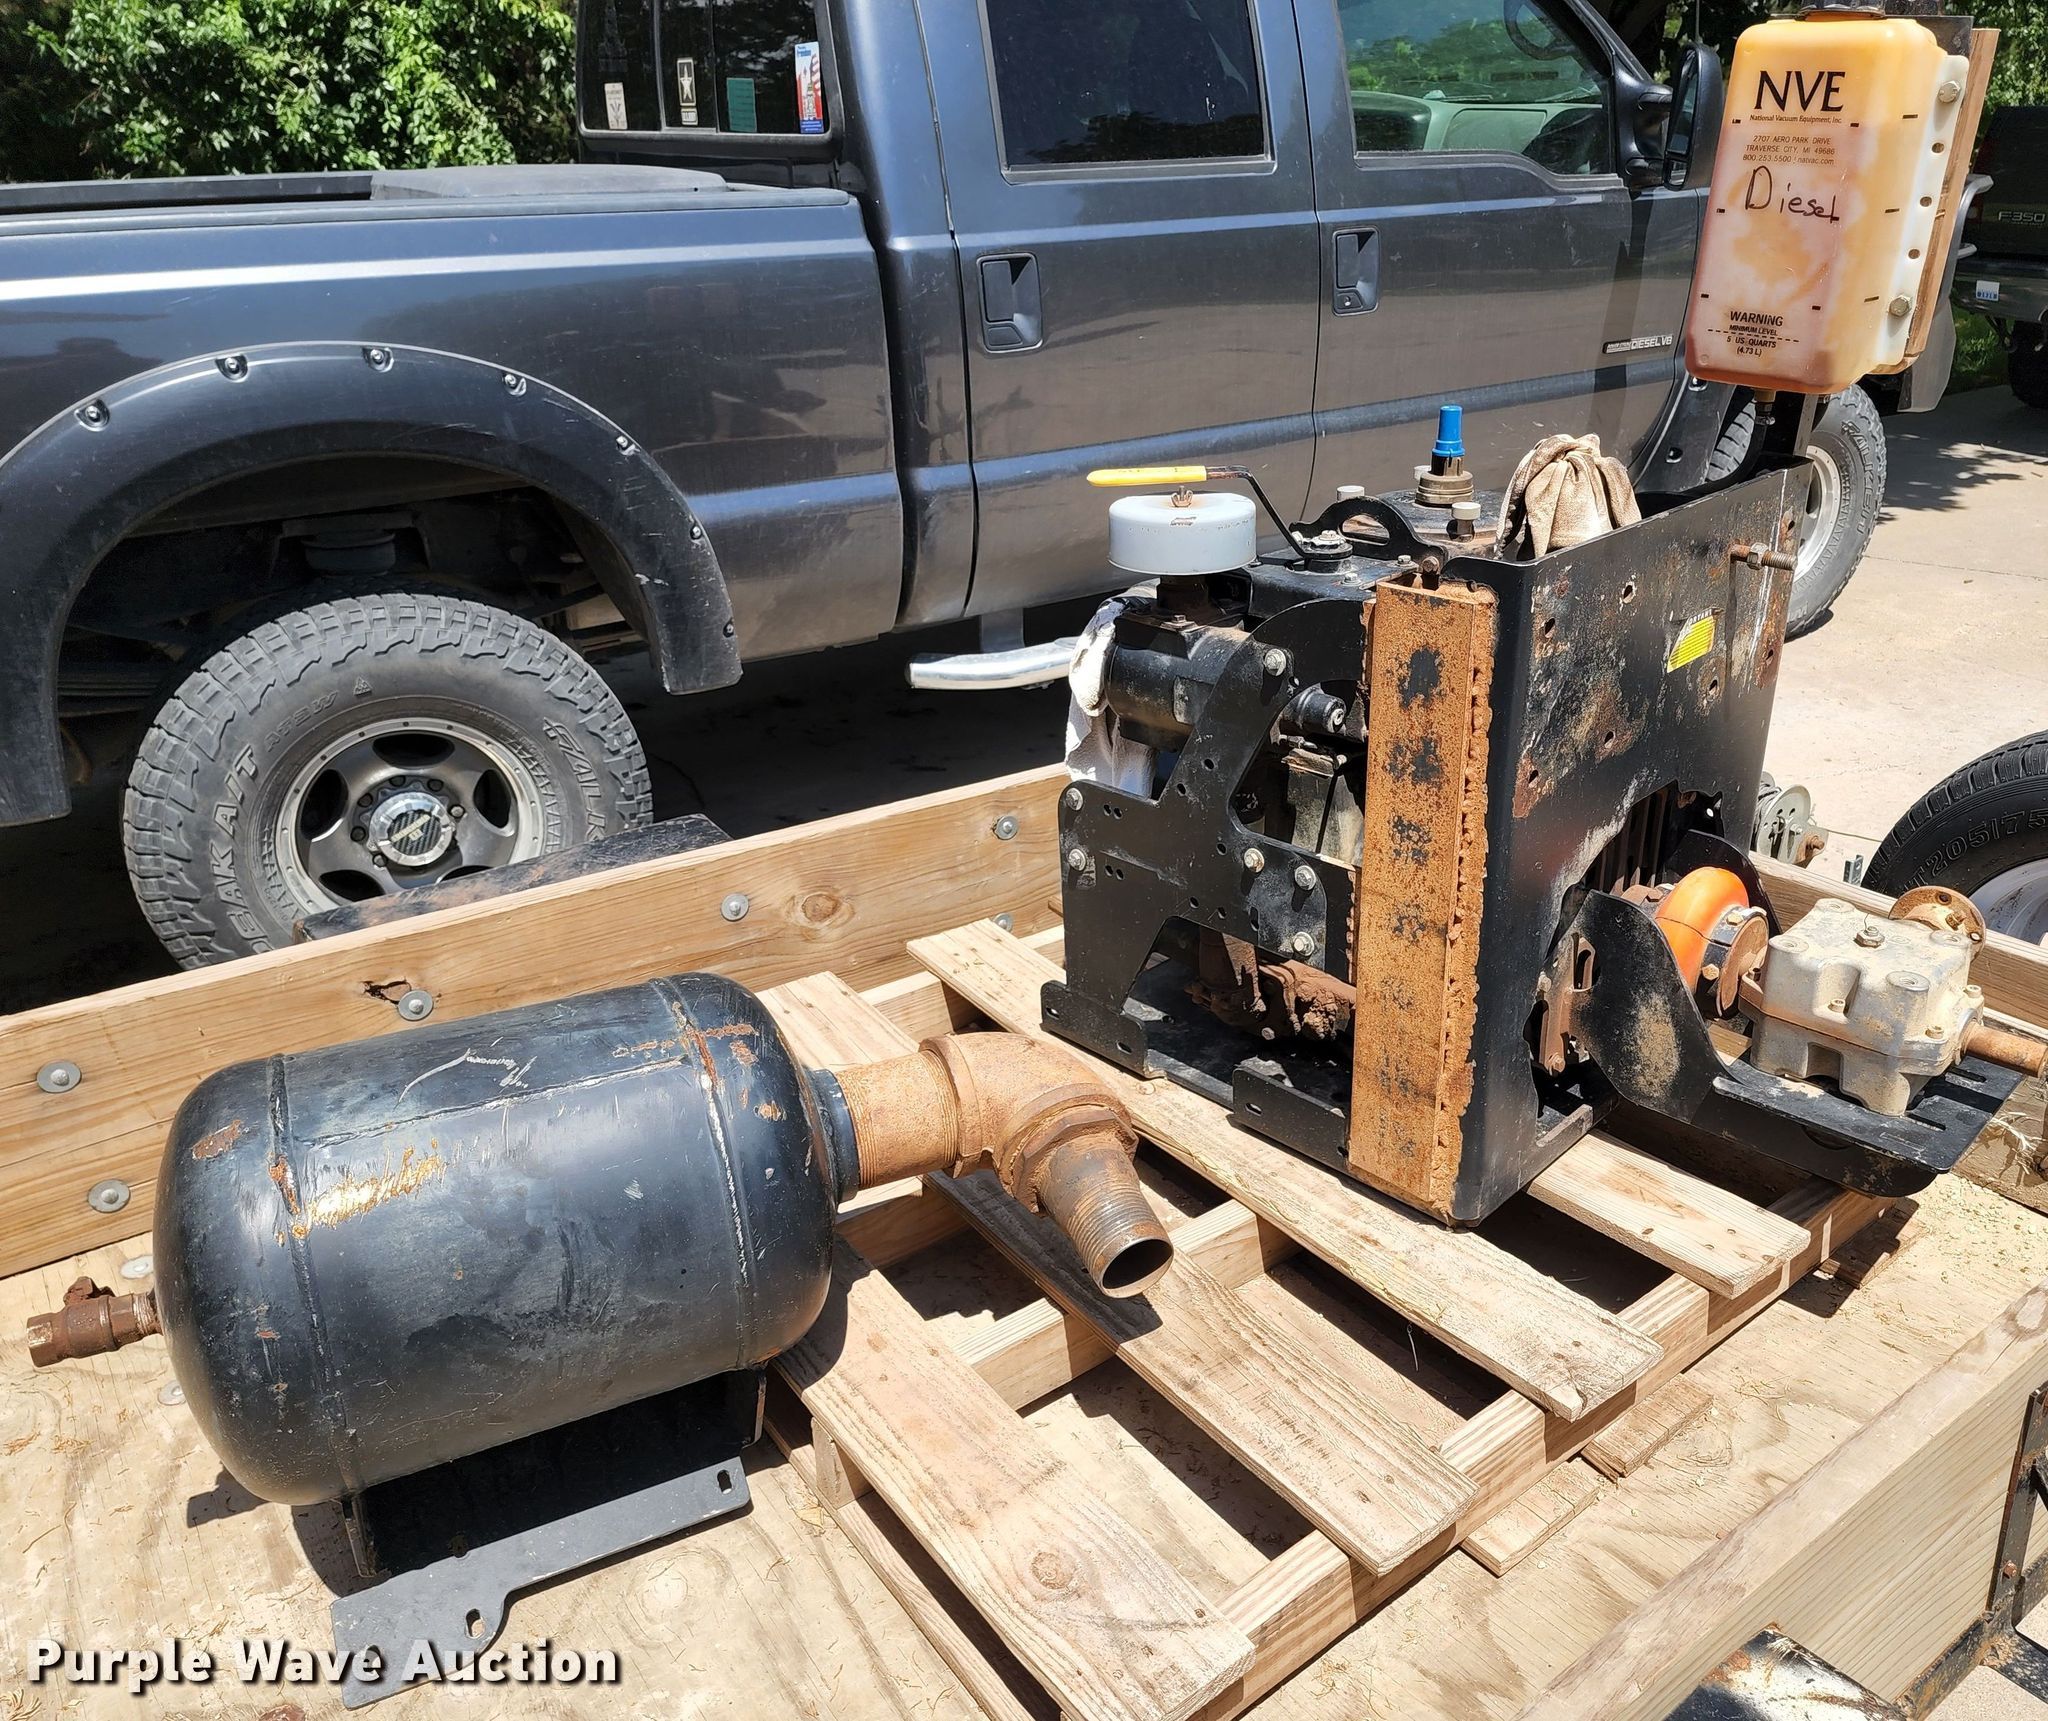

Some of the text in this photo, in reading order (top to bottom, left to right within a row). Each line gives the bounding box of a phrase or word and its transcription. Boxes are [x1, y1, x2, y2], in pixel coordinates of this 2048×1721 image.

[1754, 70, 1846, 112] NVE
[1749, 114, 1774, 122] National
[1753, 135, 1771, 143] 2707
[1791, 136, 1809, 144] PARK
[1812, 137, 1831, 145] DRIVE
[1745, 145, 1780, 153] TRAVERSE
[1814, 147, 1835, 155] 49686
[1745, 166, 1839, 223] Diesel
[1998, 211, 2046, 222] F350
[1730, 311, 1783, 327] WARNING
[1729, 325, 1778, 336] MINIMUM LEVEL
[1630, 336, 1661, 350] DIESEL
[1661, 334, 1673, 346] V8
[1748, 338, 1777, 348] QUARTS
[1736, 346, 1762, 357] (4.73 L)
